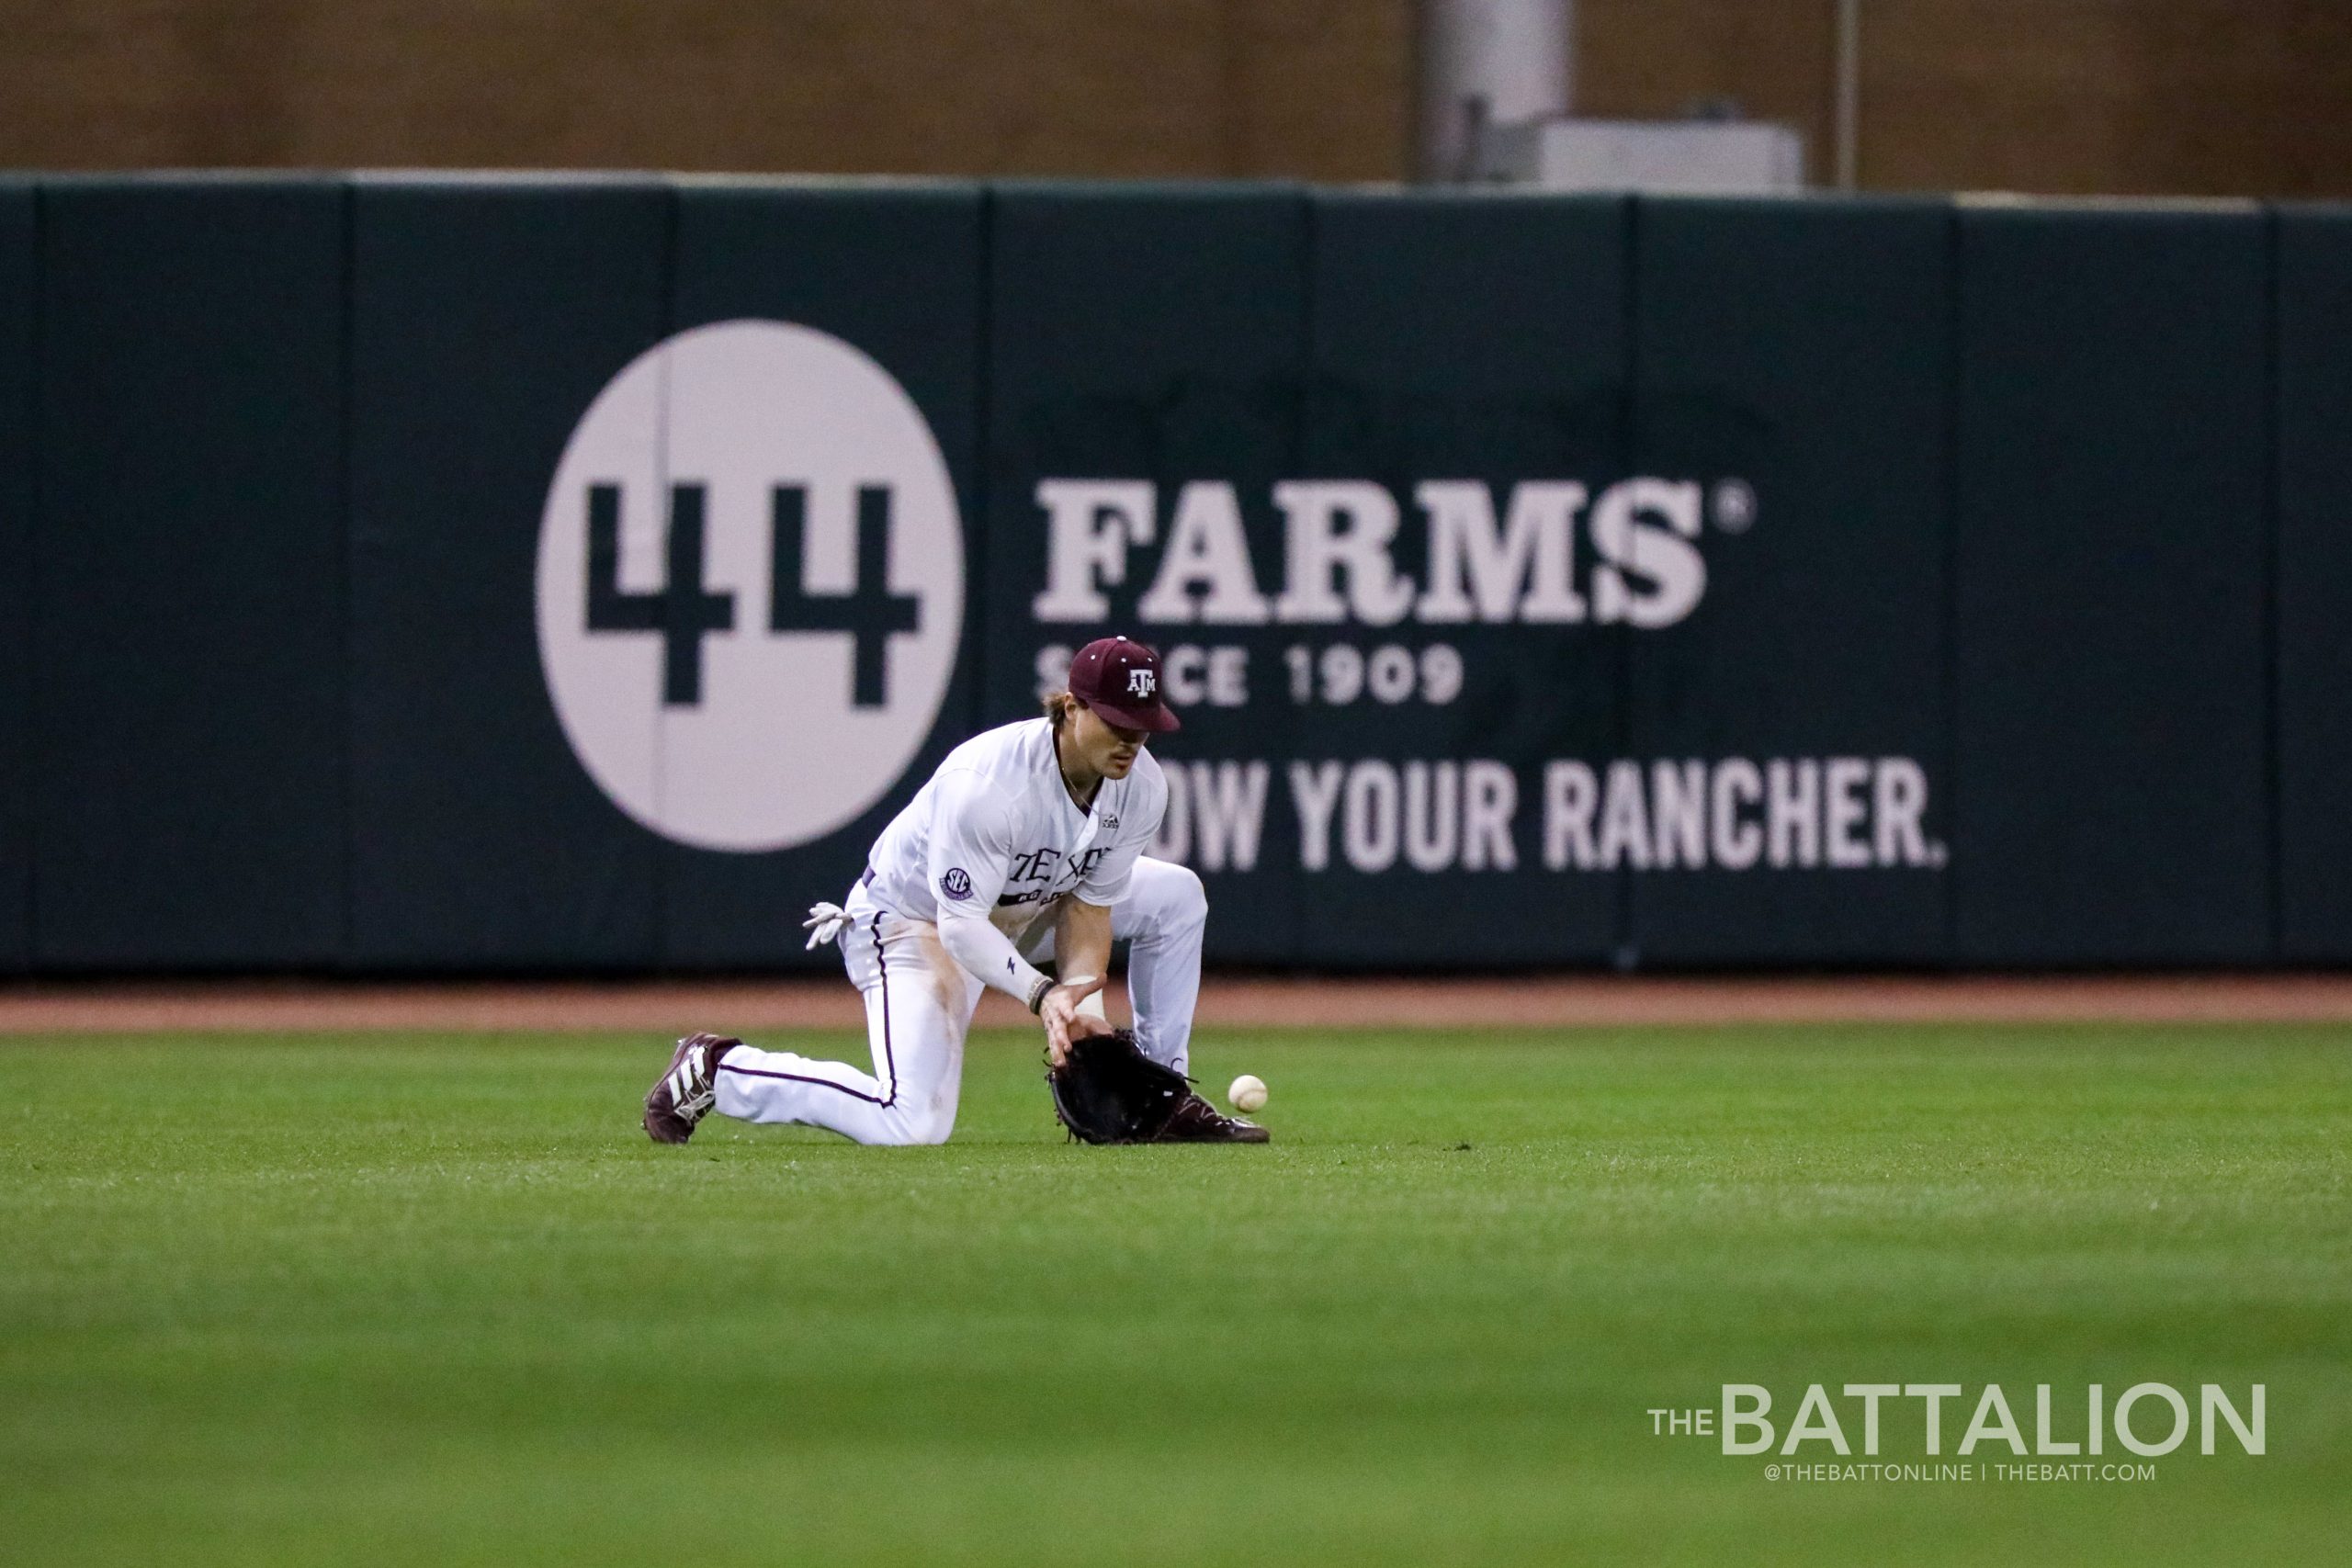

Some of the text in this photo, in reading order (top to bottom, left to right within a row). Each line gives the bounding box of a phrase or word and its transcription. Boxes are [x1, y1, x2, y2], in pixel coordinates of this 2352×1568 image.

[584, 482, 922, 711] 44
[1035, 645, 1464, 706] SCE 1909
[1291, 760, 1518, 872] YOUR
[1544, 757, 1949, 871] RANCHER.
[946, 869, 969, 893] SEC
